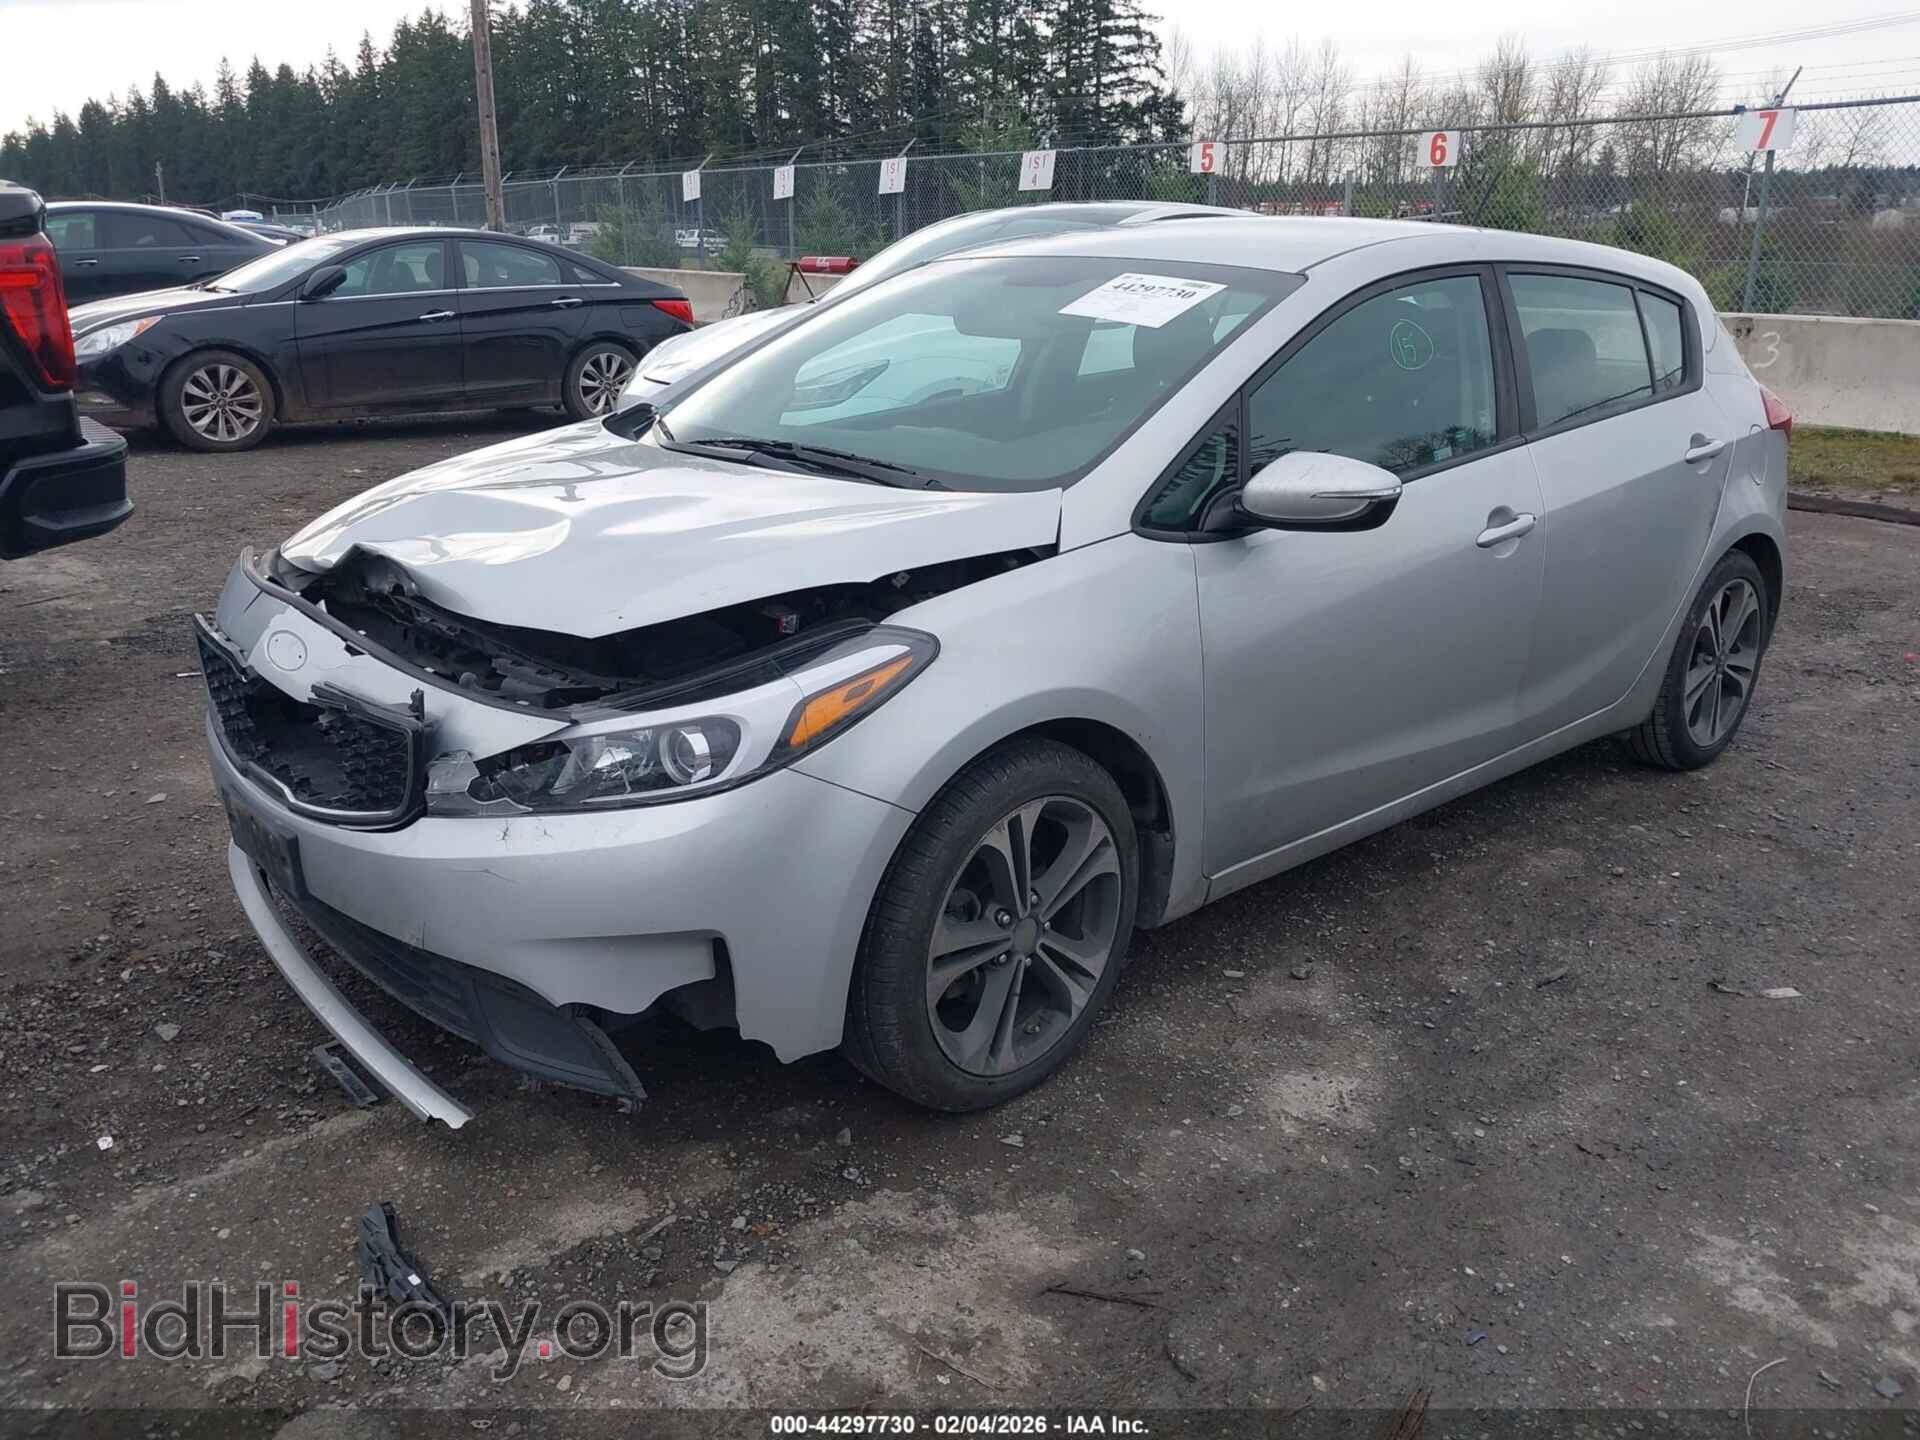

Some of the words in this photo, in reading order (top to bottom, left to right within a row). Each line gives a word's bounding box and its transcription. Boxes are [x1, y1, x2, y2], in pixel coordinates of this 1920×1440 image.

[1757, 111, 1778, 150] 7
[1200, 143, 1214, 172] 5
[1429, 132, 1447, 165] 6
[1112, 282, 1198, 299] 44297730
[1752, 331, 1781, 369] 3
